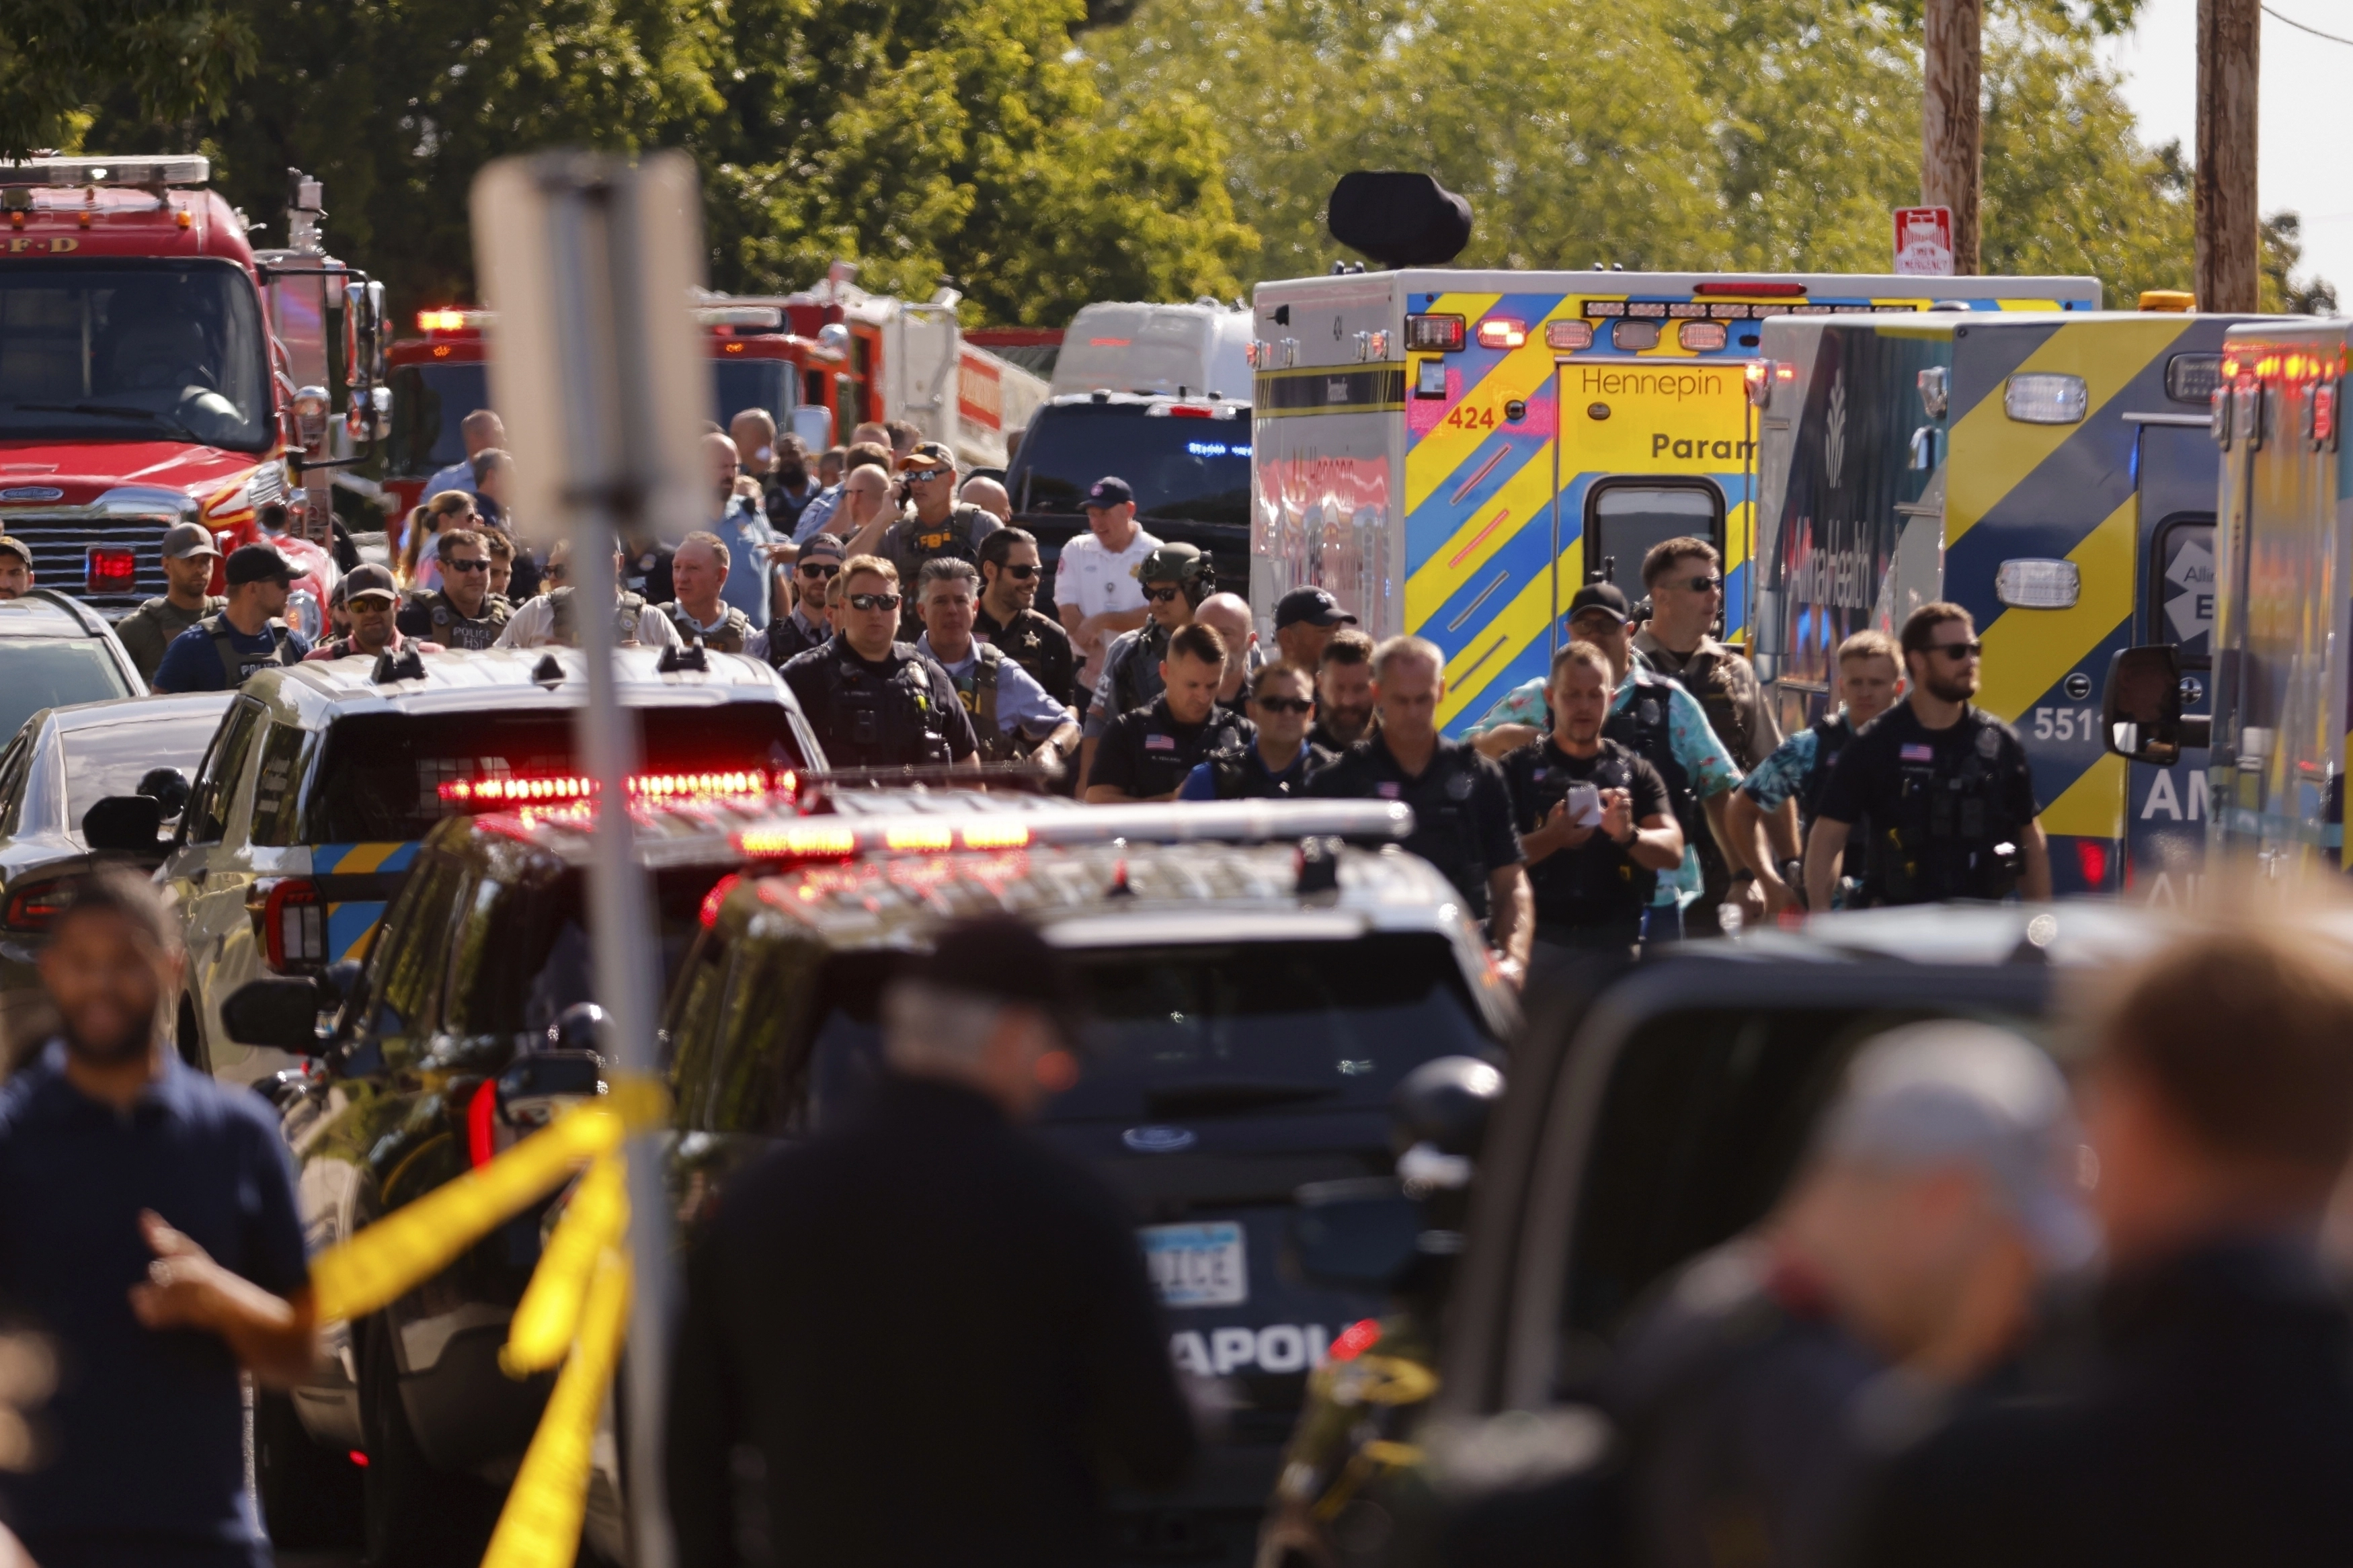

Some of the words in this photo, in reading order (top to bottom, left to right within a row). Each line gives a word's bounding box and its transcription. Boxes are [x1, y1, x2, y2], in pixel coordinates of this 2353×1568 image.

[1583, 368, 1722, 402] Hennepin
[1447, 407, 1494, 429] 424
[452, 626, 492, 641] POLICE
[2034, 708, 2103, 741] 551
